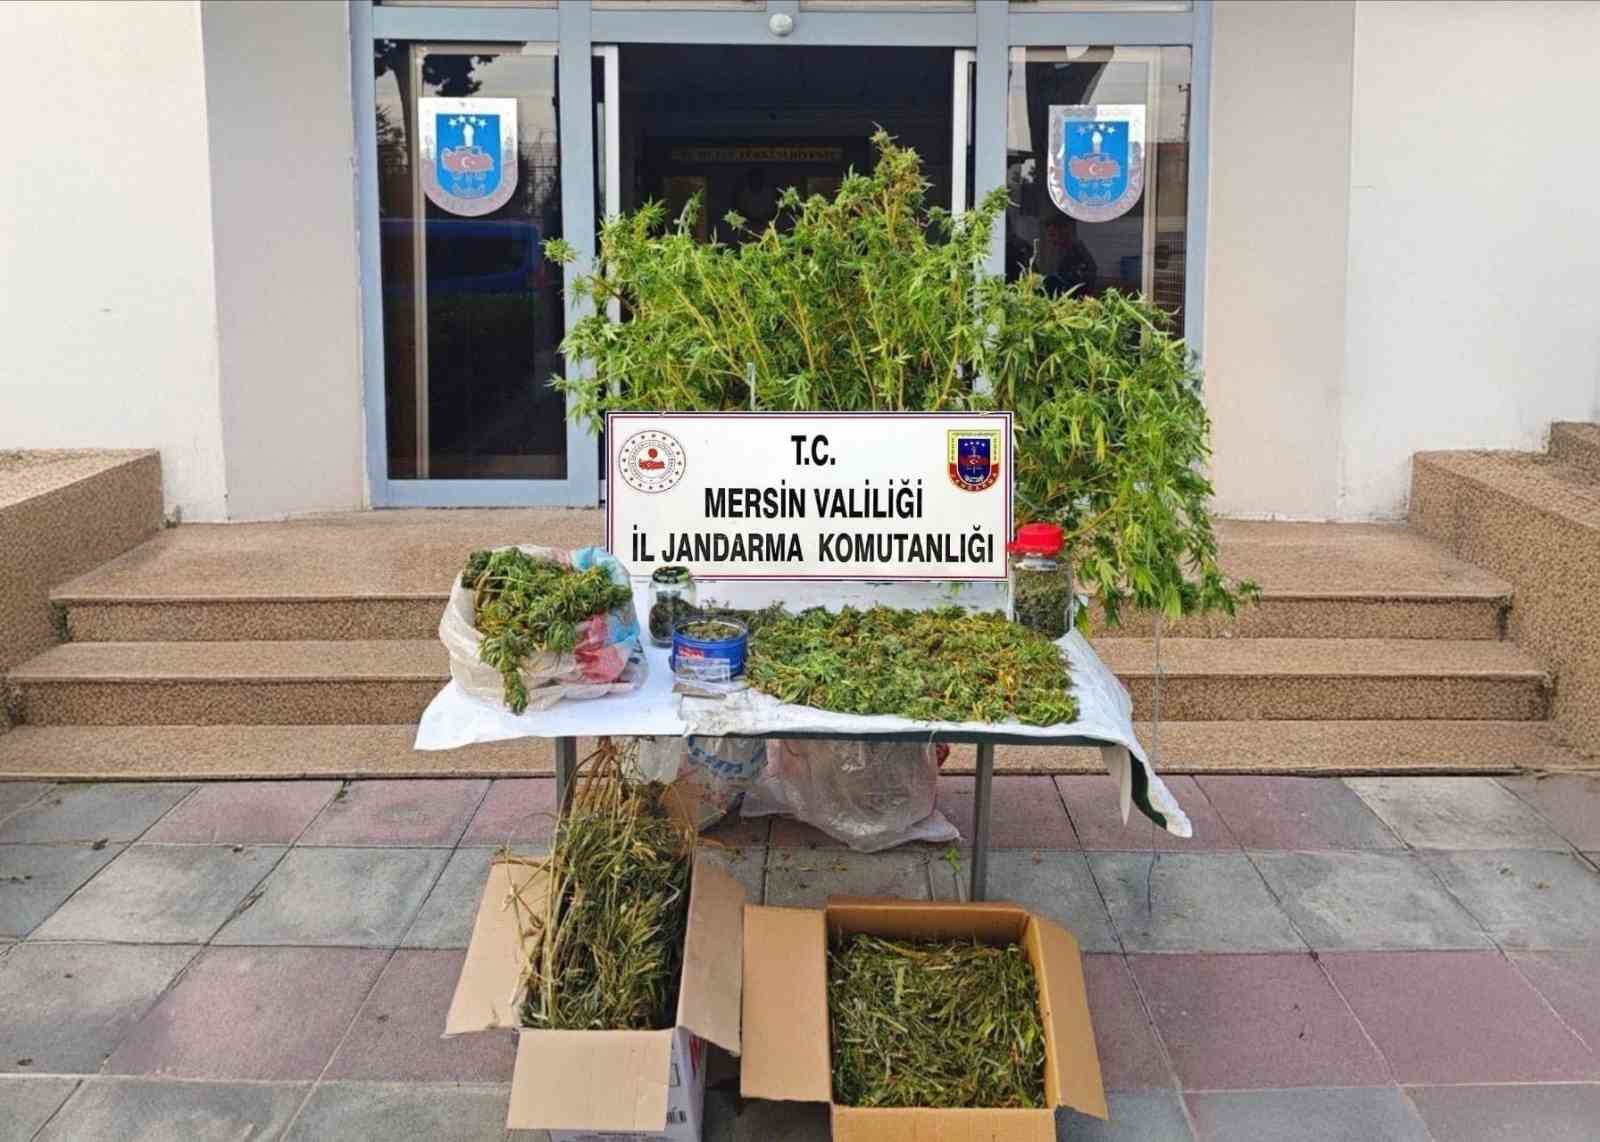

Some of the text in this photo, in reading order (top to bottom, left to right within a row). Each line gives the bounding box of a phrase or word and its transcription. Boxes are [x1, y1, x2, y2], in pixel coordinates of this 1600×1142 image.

[790, 434, 836, 466] T.C.
[704, 480, 806, 518] MERSİN
[813, 478, 922, 518] VALİLİĞİ
[632, 525, 994, 562] İL JANDARMA KOMUTANLIĞI
